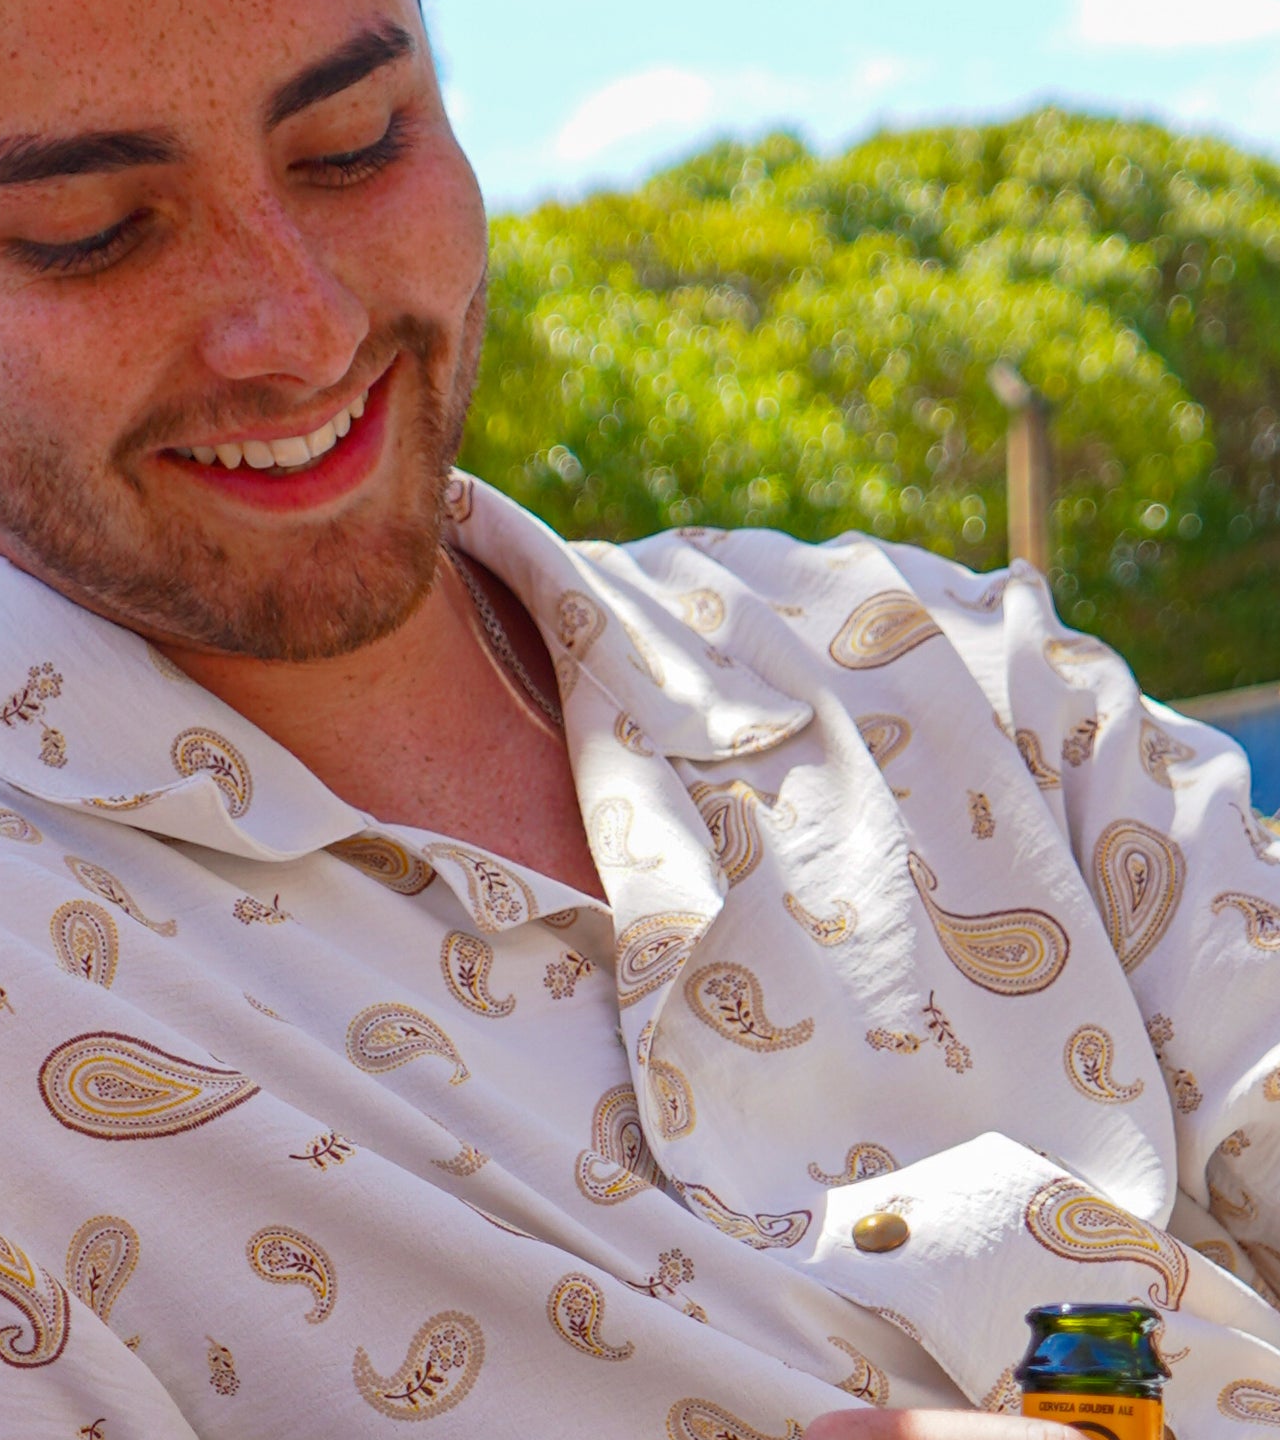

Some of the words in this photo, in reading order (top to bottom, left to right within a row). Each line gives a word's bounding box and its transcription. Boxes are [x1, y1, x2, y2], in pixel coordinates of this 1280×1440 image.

[1038, 1401, 1075, 1413] CERVEZA
[1078, 1403, 1115, 1415] GOLDEN
[1118, 1405, 1134, 1416] ALE
